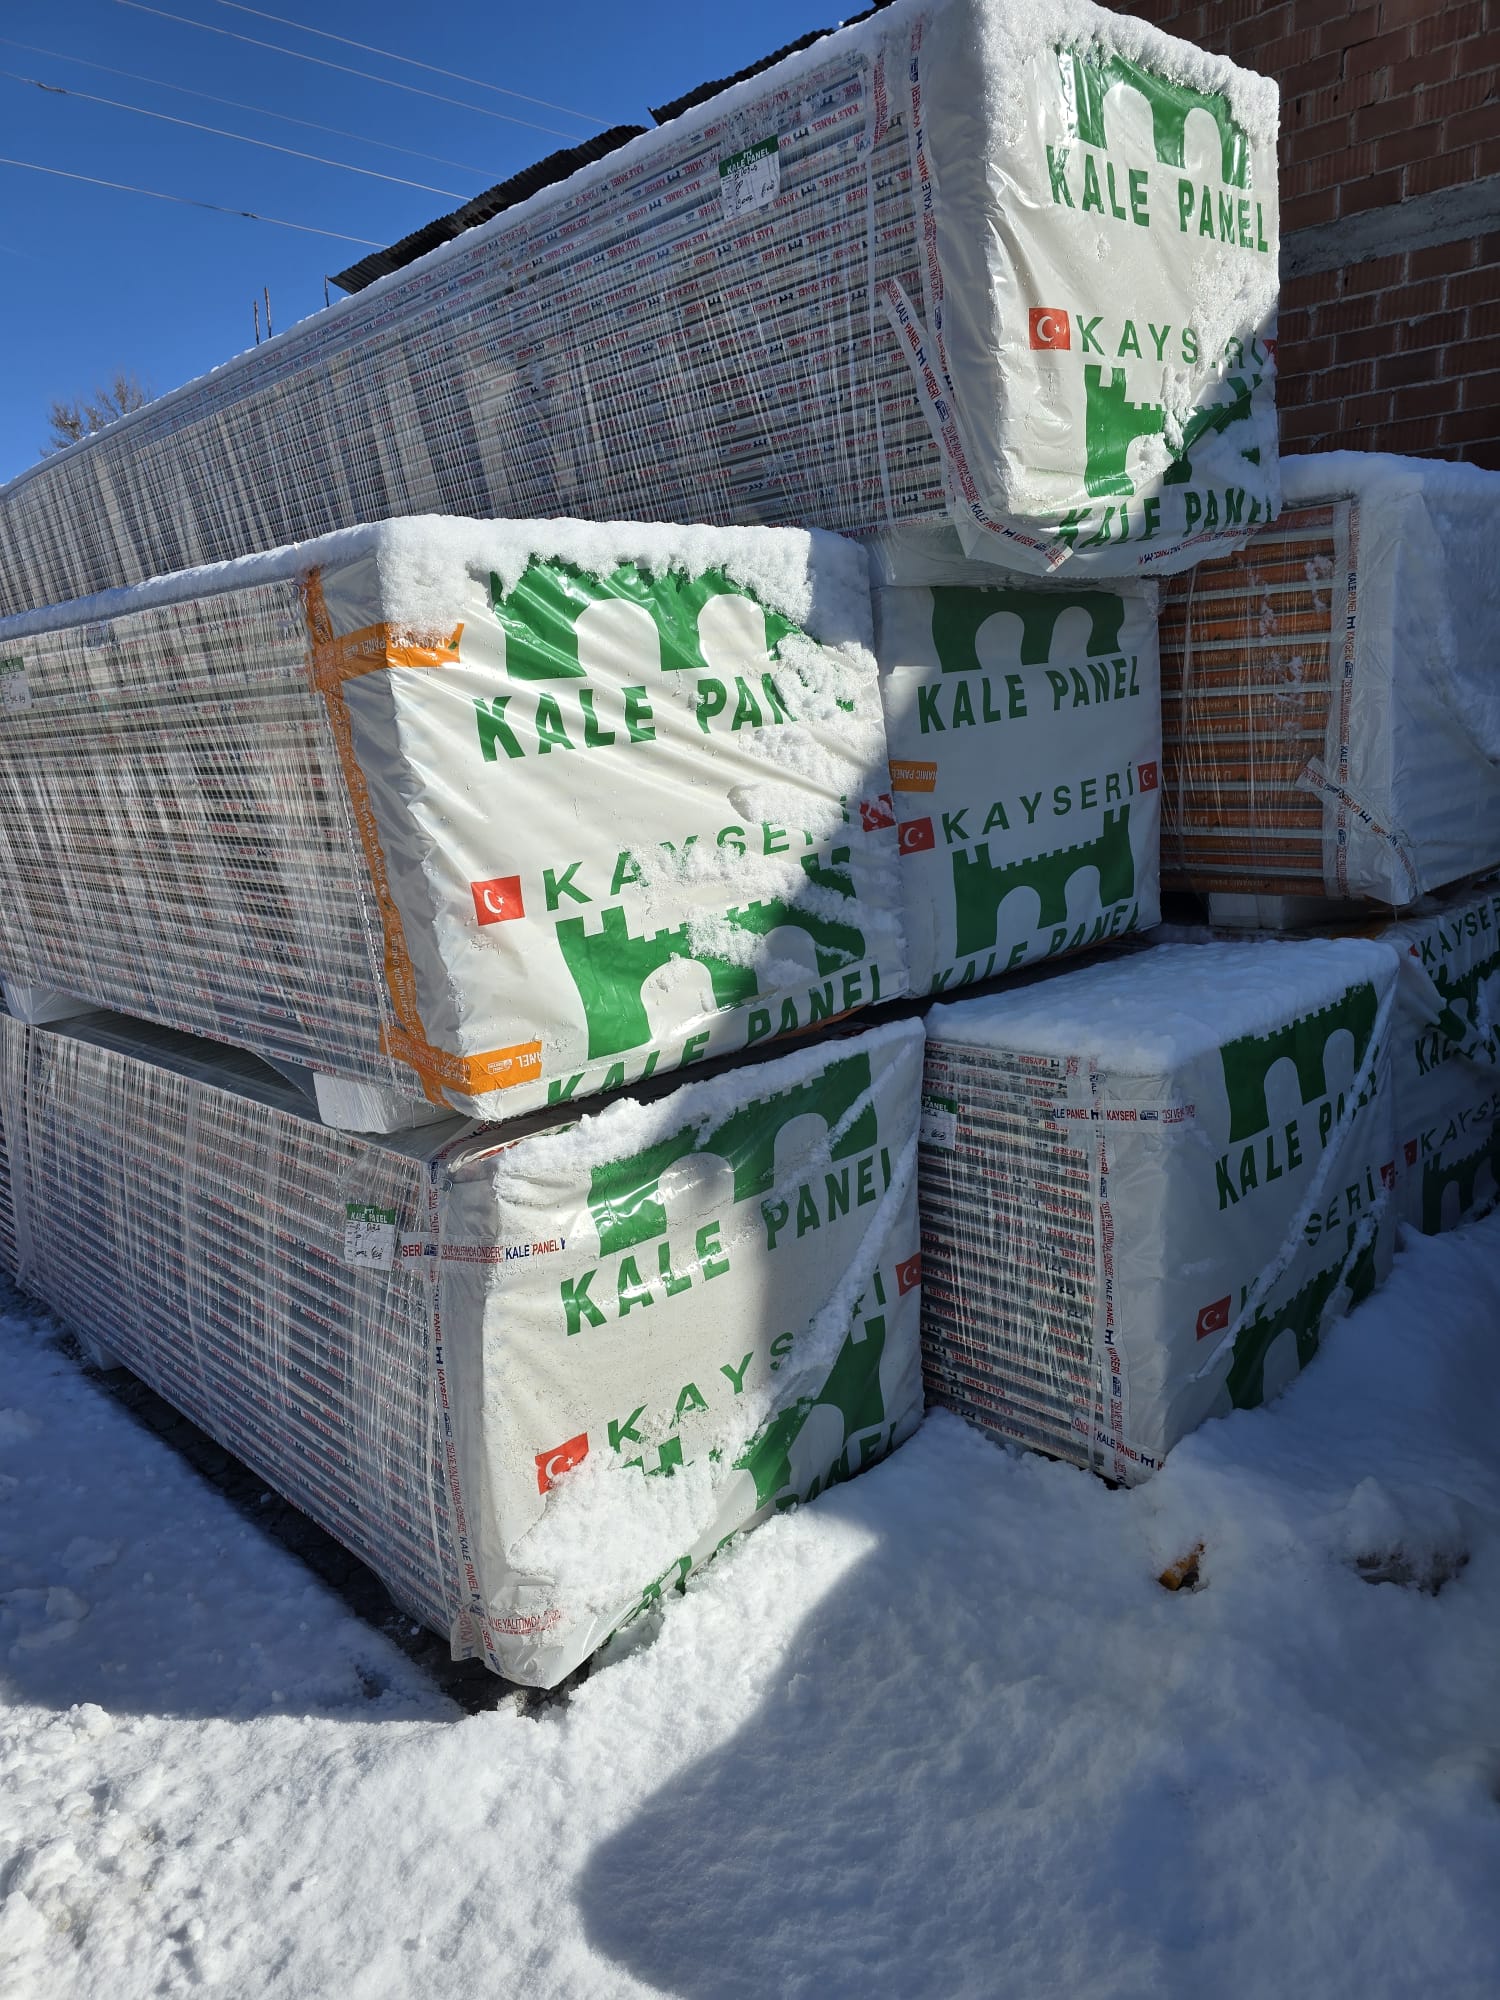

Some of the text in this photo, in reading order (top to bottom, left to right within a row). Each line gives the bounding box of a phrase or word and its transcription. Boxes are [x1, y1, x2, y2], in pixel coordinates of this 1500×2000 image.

[727, 158, 746, 175] KALE
[916, 150, 929, 182] PANEL
[921, 181, 933, 209] KALE
[1046, 143, 1269, 253] KALE PANEL
[891, 300, 912, 325] KALE
[901, 321, 923, 351] PANEL
[1076, 314, 1264, 370] KAYSRİ
[966, 500, 991, 525] KALE
[1053, 496, 1161, 548] KALE
[1347, 572, 1356, 591] KALE
[917, 655, 1141, 734] KALE PANEL
[473, 685, 656, 762] KALE
[1339, 745, 1348, 763] KALE
[941, 762, 1135, 844] KAYSERİ
[931, 901, 1139, 994] KALE PANEL
[547, 1030, 711, 1105] KALE
[748, 964, 881, 1047] PANEL
[1066, 1109, 1089, 1120] PANEL
[1107, 1108, 1136, 1121] KAYSERİ
[1215, 1119, 1303, 1211] KALE
[504, 1243, 531, 1260] KALE
[530, 1238, 560, 1255] PANEL
[560, 1146, 893, 1335] KALE PANEL
[1104, 1278, 1113, 1301] KALE
[433, 1312, 441, 1343] PANEL
[1104, 1301, 1114, 1327] PANEL
[607, 1265, 887, 1455] KAYSİ
[1093, 1426, 1142, 1463] KALE PANEL
[458, 1535, 472, 1563] KALE
[464, 1562, 478, 1591] PANEL
